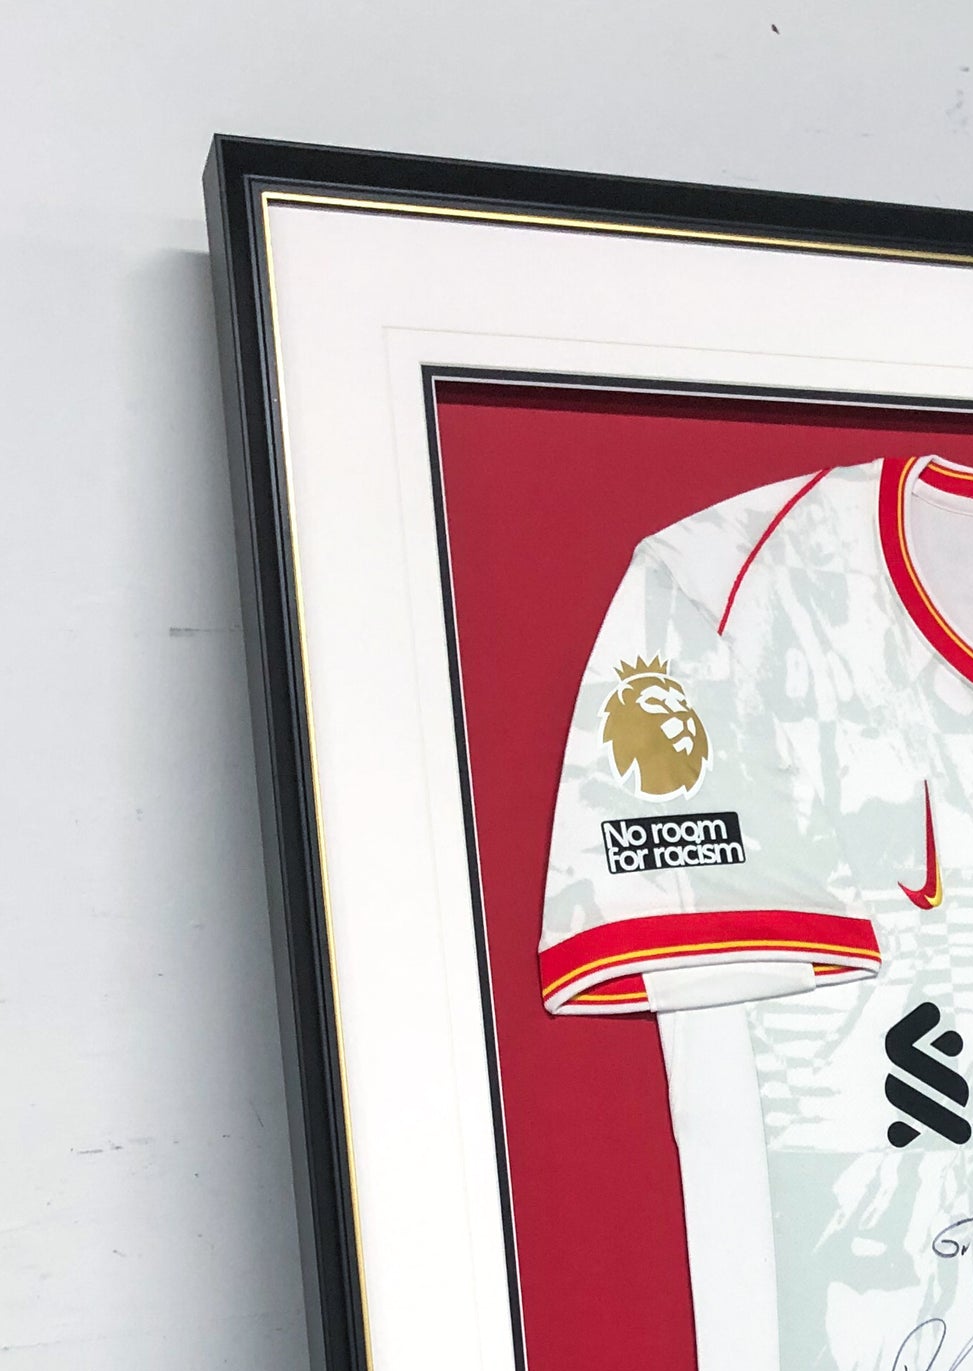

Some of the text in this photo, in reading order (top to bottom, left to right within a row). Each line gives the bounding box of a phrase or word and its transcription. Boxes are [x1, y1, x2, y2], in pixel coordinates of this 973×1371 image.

[603, 819, 728, 848] No room
[608, 842, 745, 872] for racism
